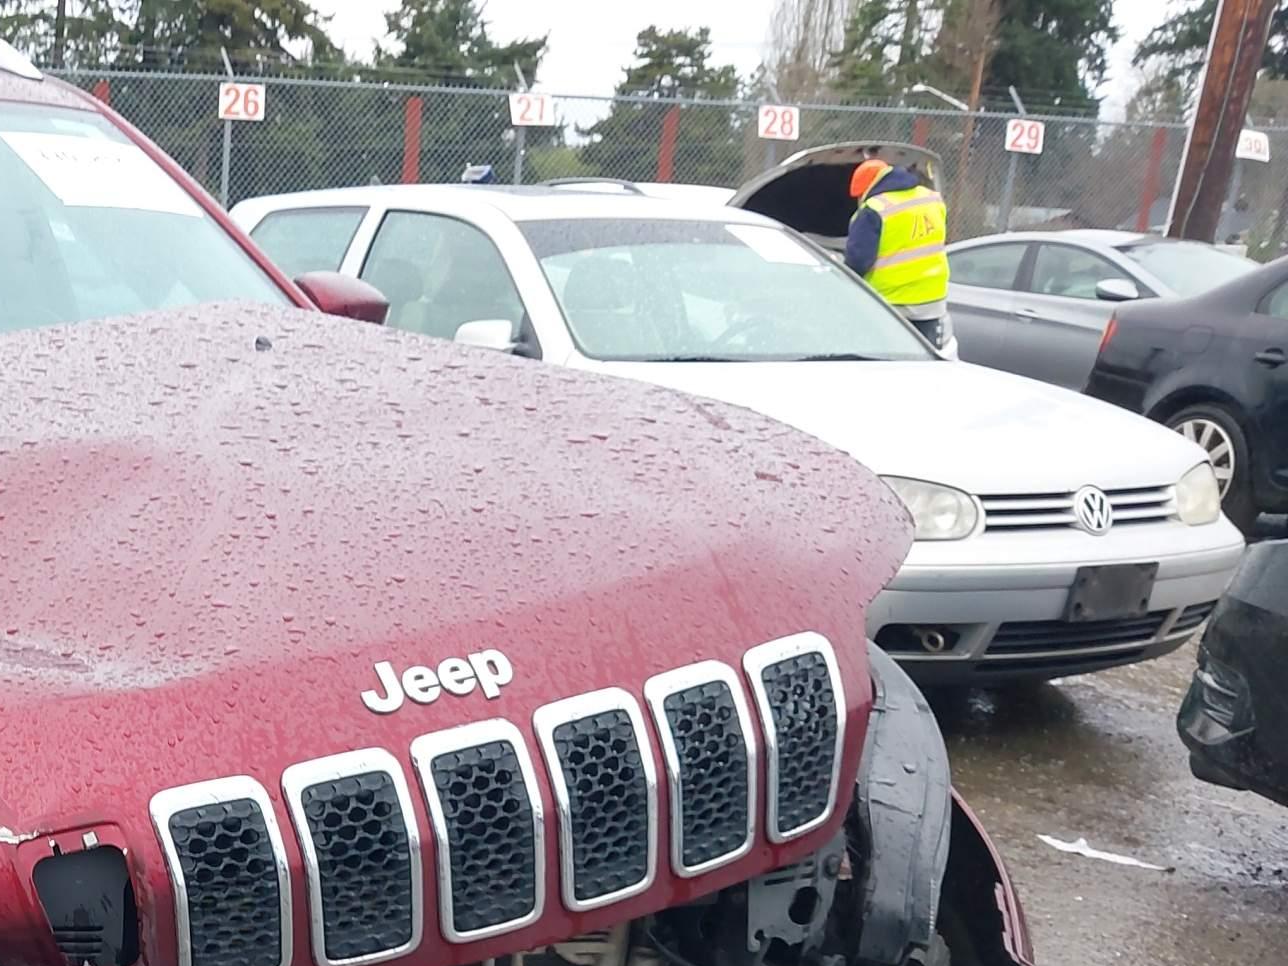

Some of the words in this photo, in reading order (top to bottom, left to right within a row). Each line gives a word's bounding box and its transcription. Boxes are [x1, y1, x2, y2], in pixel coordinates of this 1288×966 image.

[223, 87, 259, 117] 26
[517, 95, 544, 122] 27
[763, 109, 794, 136] 28
[1011, 122, 1039, 150] 29
[360, 648, 513, 715] Jeep
